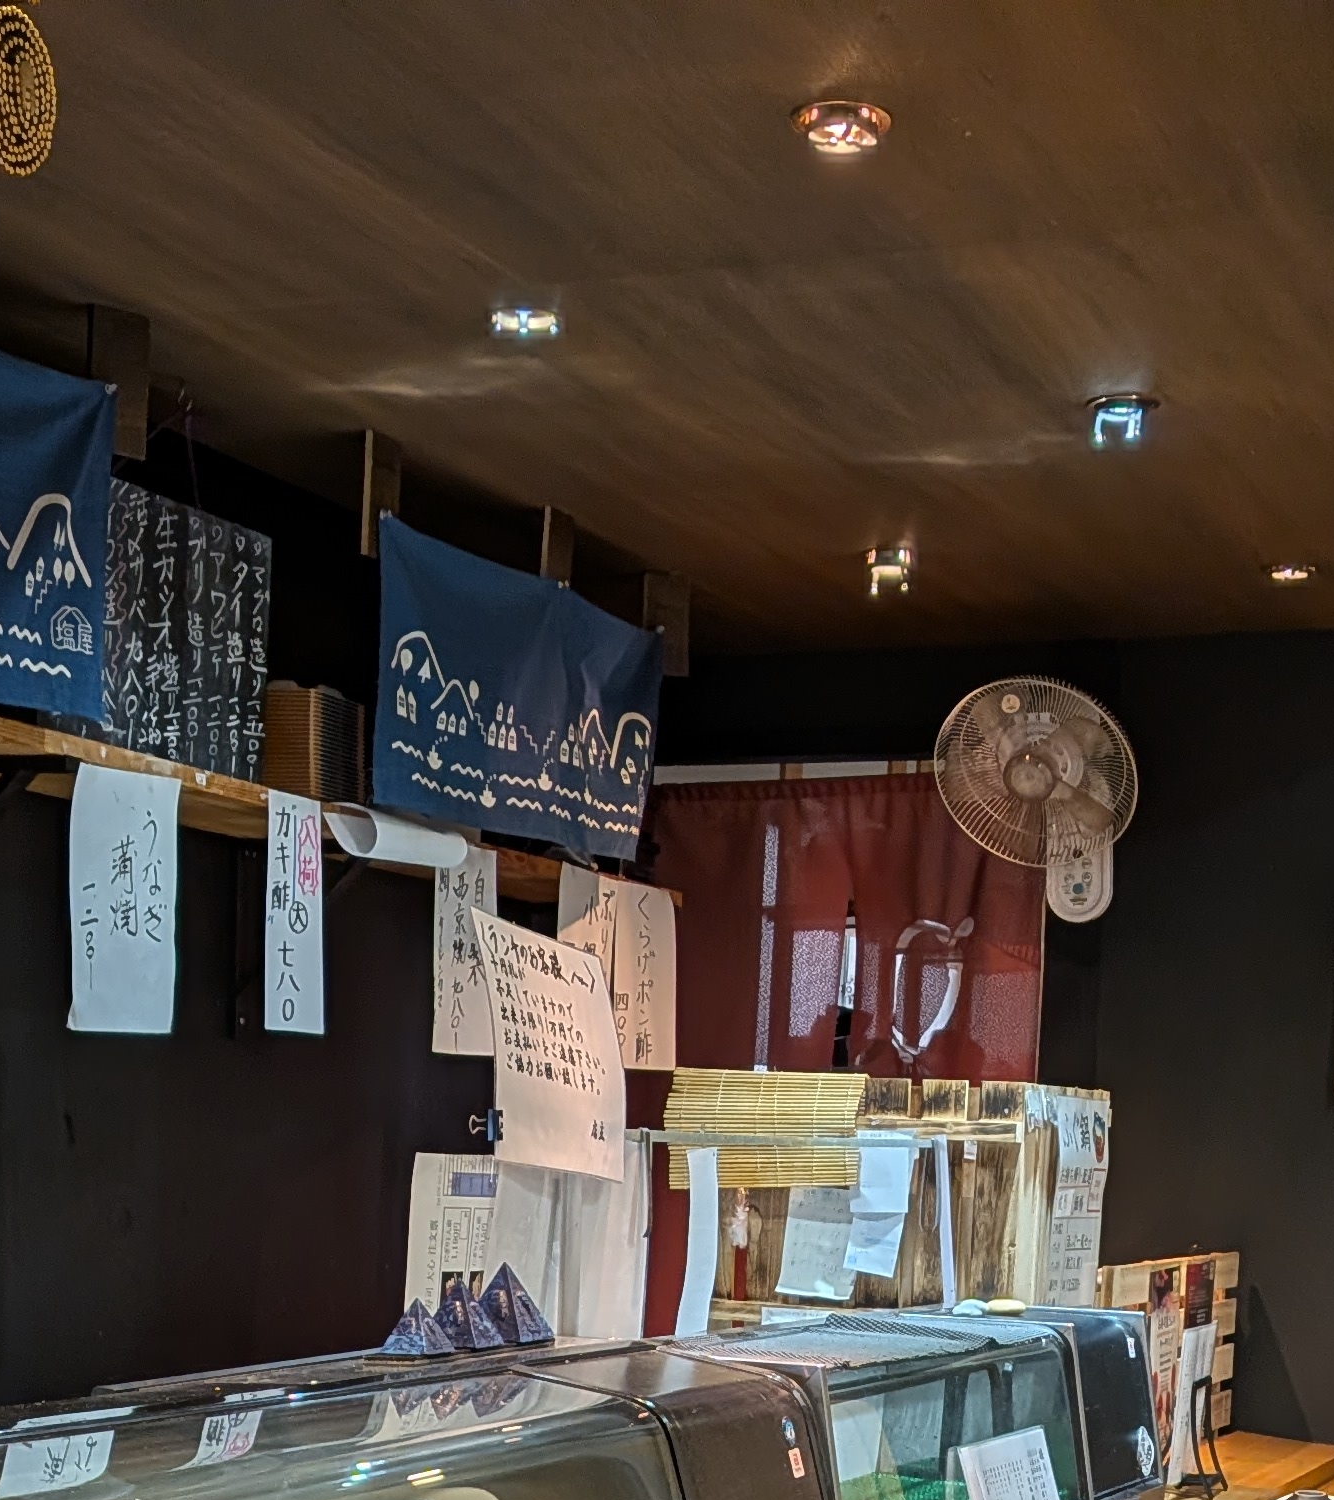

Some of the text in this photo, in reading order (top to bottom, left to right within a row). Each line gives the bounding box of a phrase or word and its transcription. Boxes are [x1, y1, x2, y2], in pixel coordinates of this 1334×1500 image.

[110, 835, 137, 936] 蒲焼
[142, 810, 167, 942] うなぎ
[636, 892, 656, 1065] くらげポン酢
